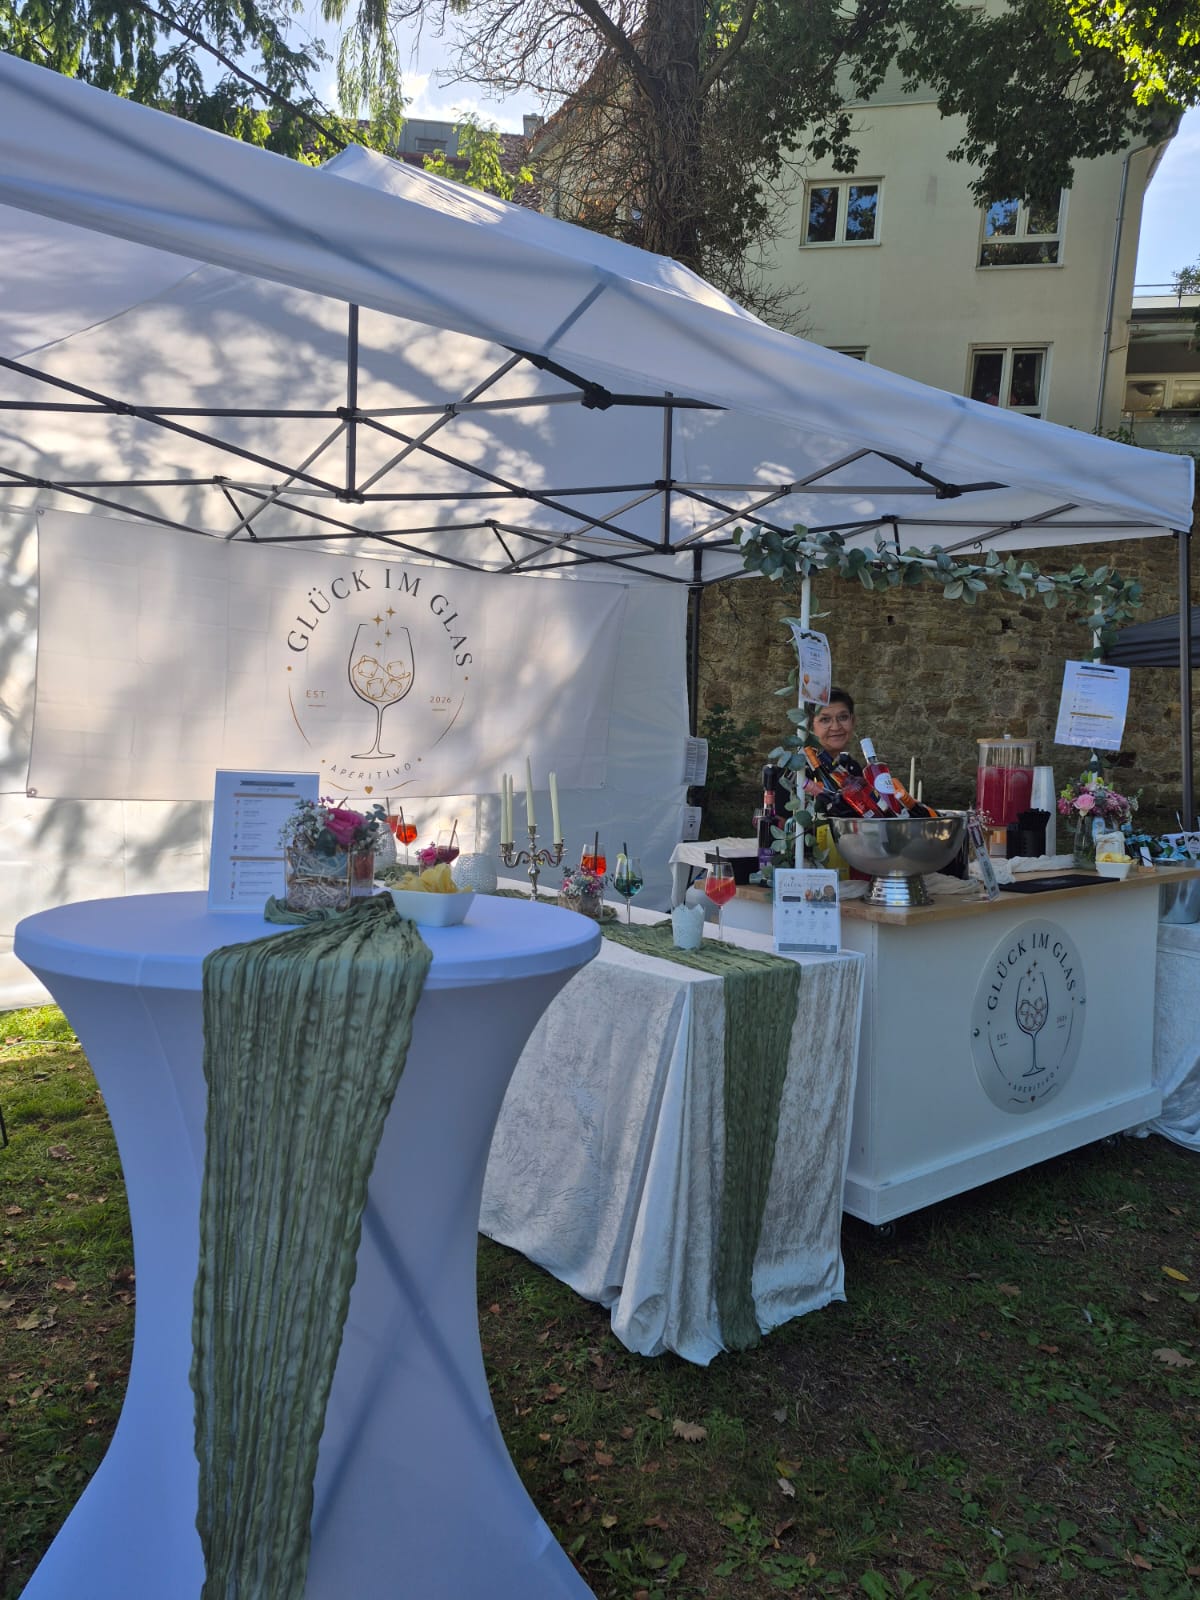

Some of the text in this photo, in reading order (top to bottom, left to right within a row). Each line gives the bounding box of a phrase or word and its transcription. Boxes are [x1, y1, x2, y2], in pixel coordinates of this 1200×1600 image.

[287, 568, 473, 667] GLÜCK IM GLAS
[305, 689, 327, 698] EST
[330, 762, 411, 780] APERITIVO
[987, 932, 1077, 1011] GLÜCK IM GLAS
